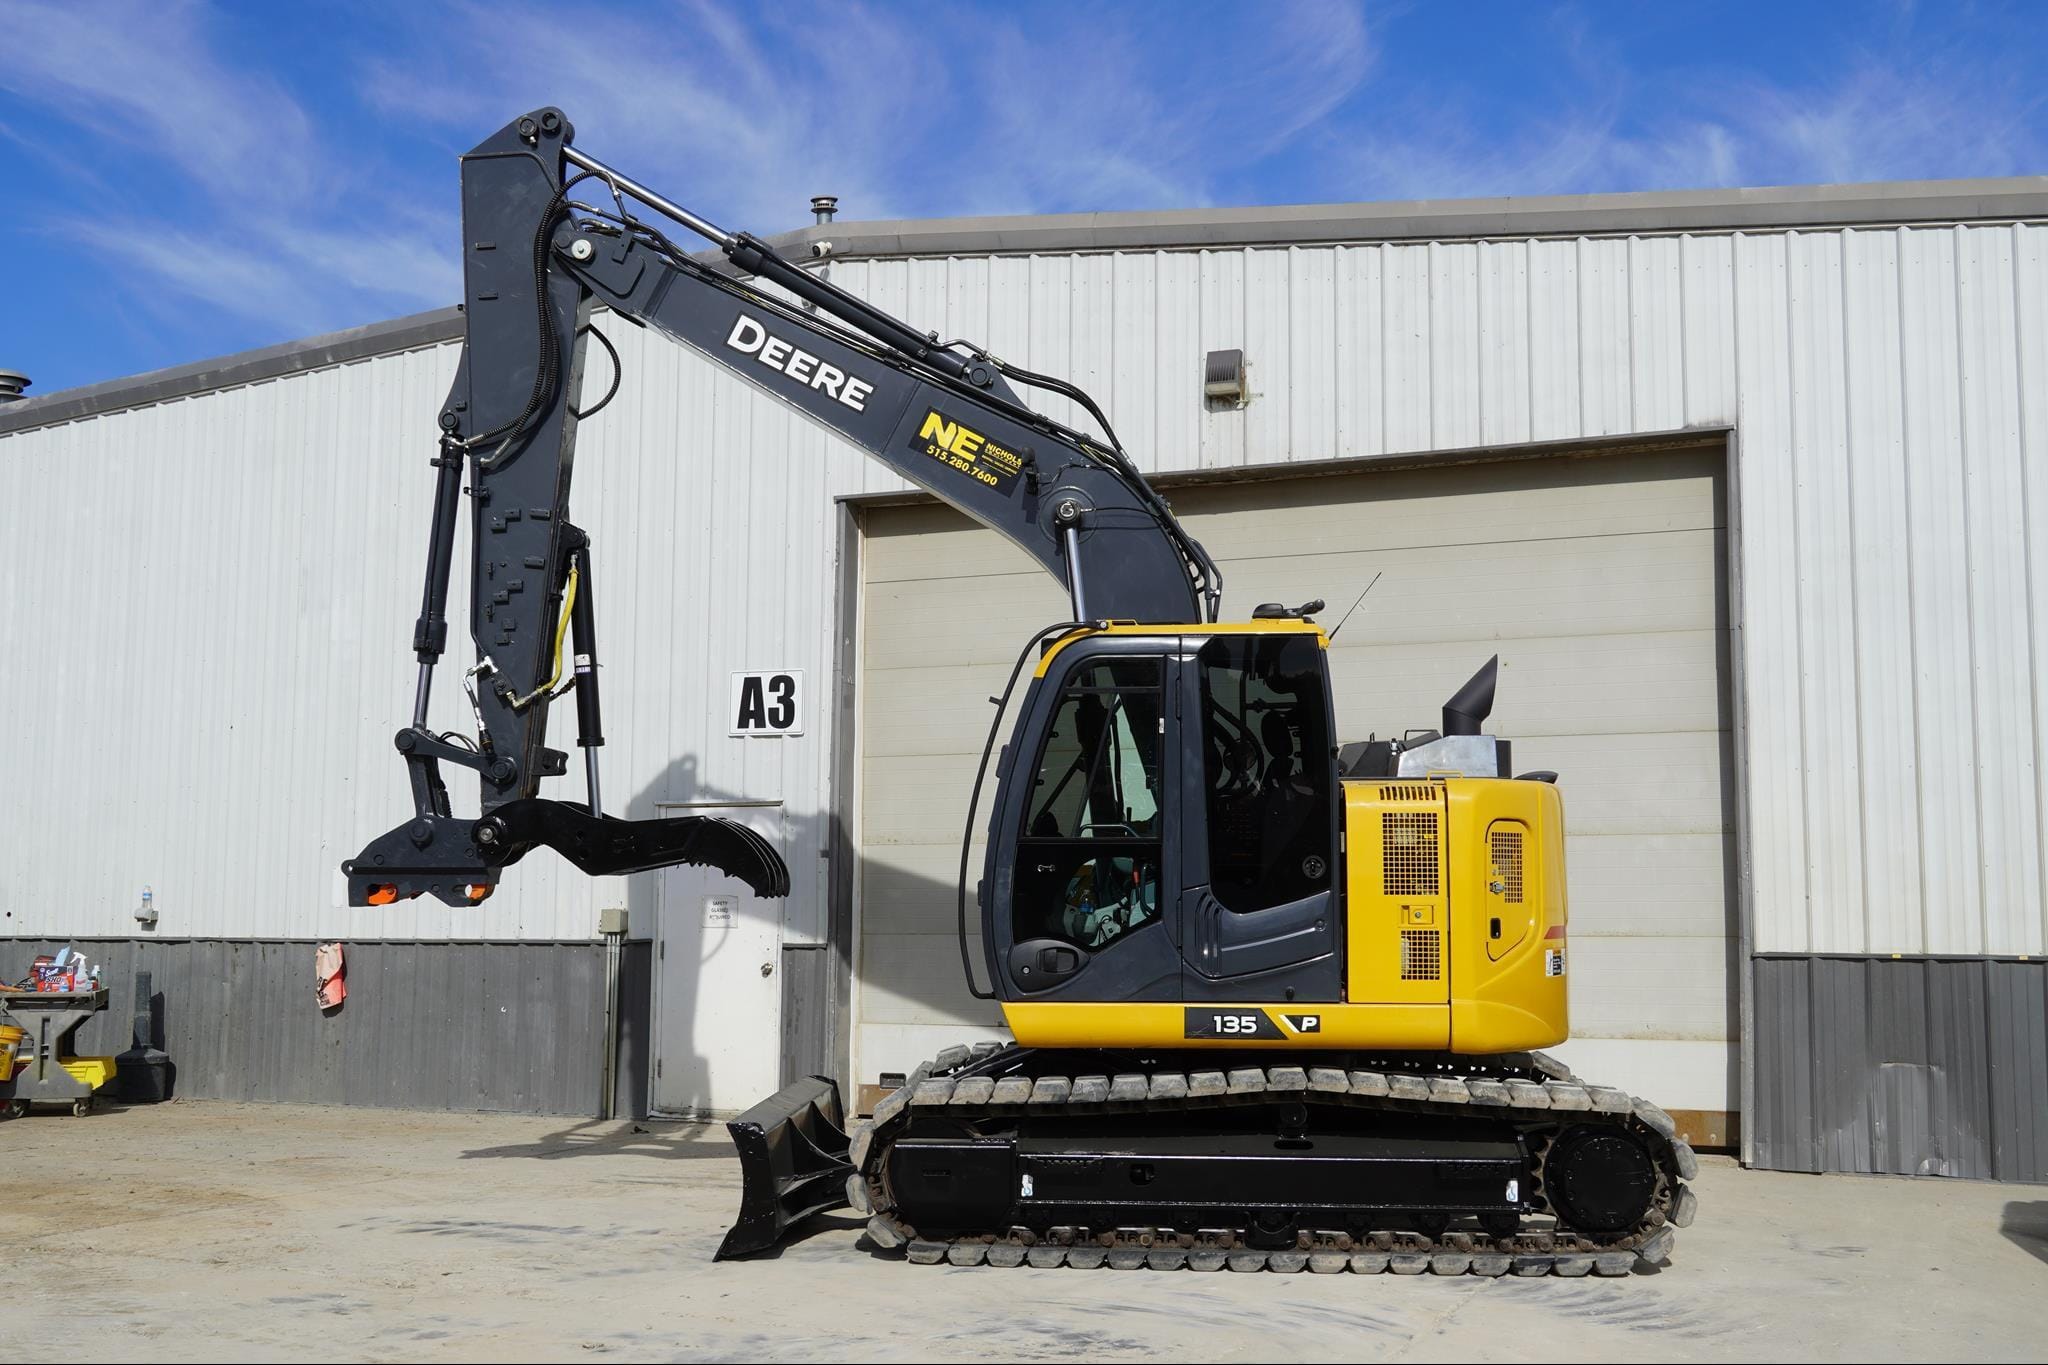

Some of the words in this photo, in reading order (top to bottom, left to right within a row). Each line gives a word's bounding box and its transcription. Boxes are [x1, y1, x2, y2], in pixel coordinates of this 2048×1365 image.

[727, 314, 874, 412] DEERE
[919, 411, 986, 463] NE
[985, 442, 1023, 466] NICHOLS
[926, 445, 998, 486] 515.280.7600
[737, 674, 796, 730] A3
[1213, 1015, 1258, 1033] 135
[1301, 1016, 1318, 1031] P
